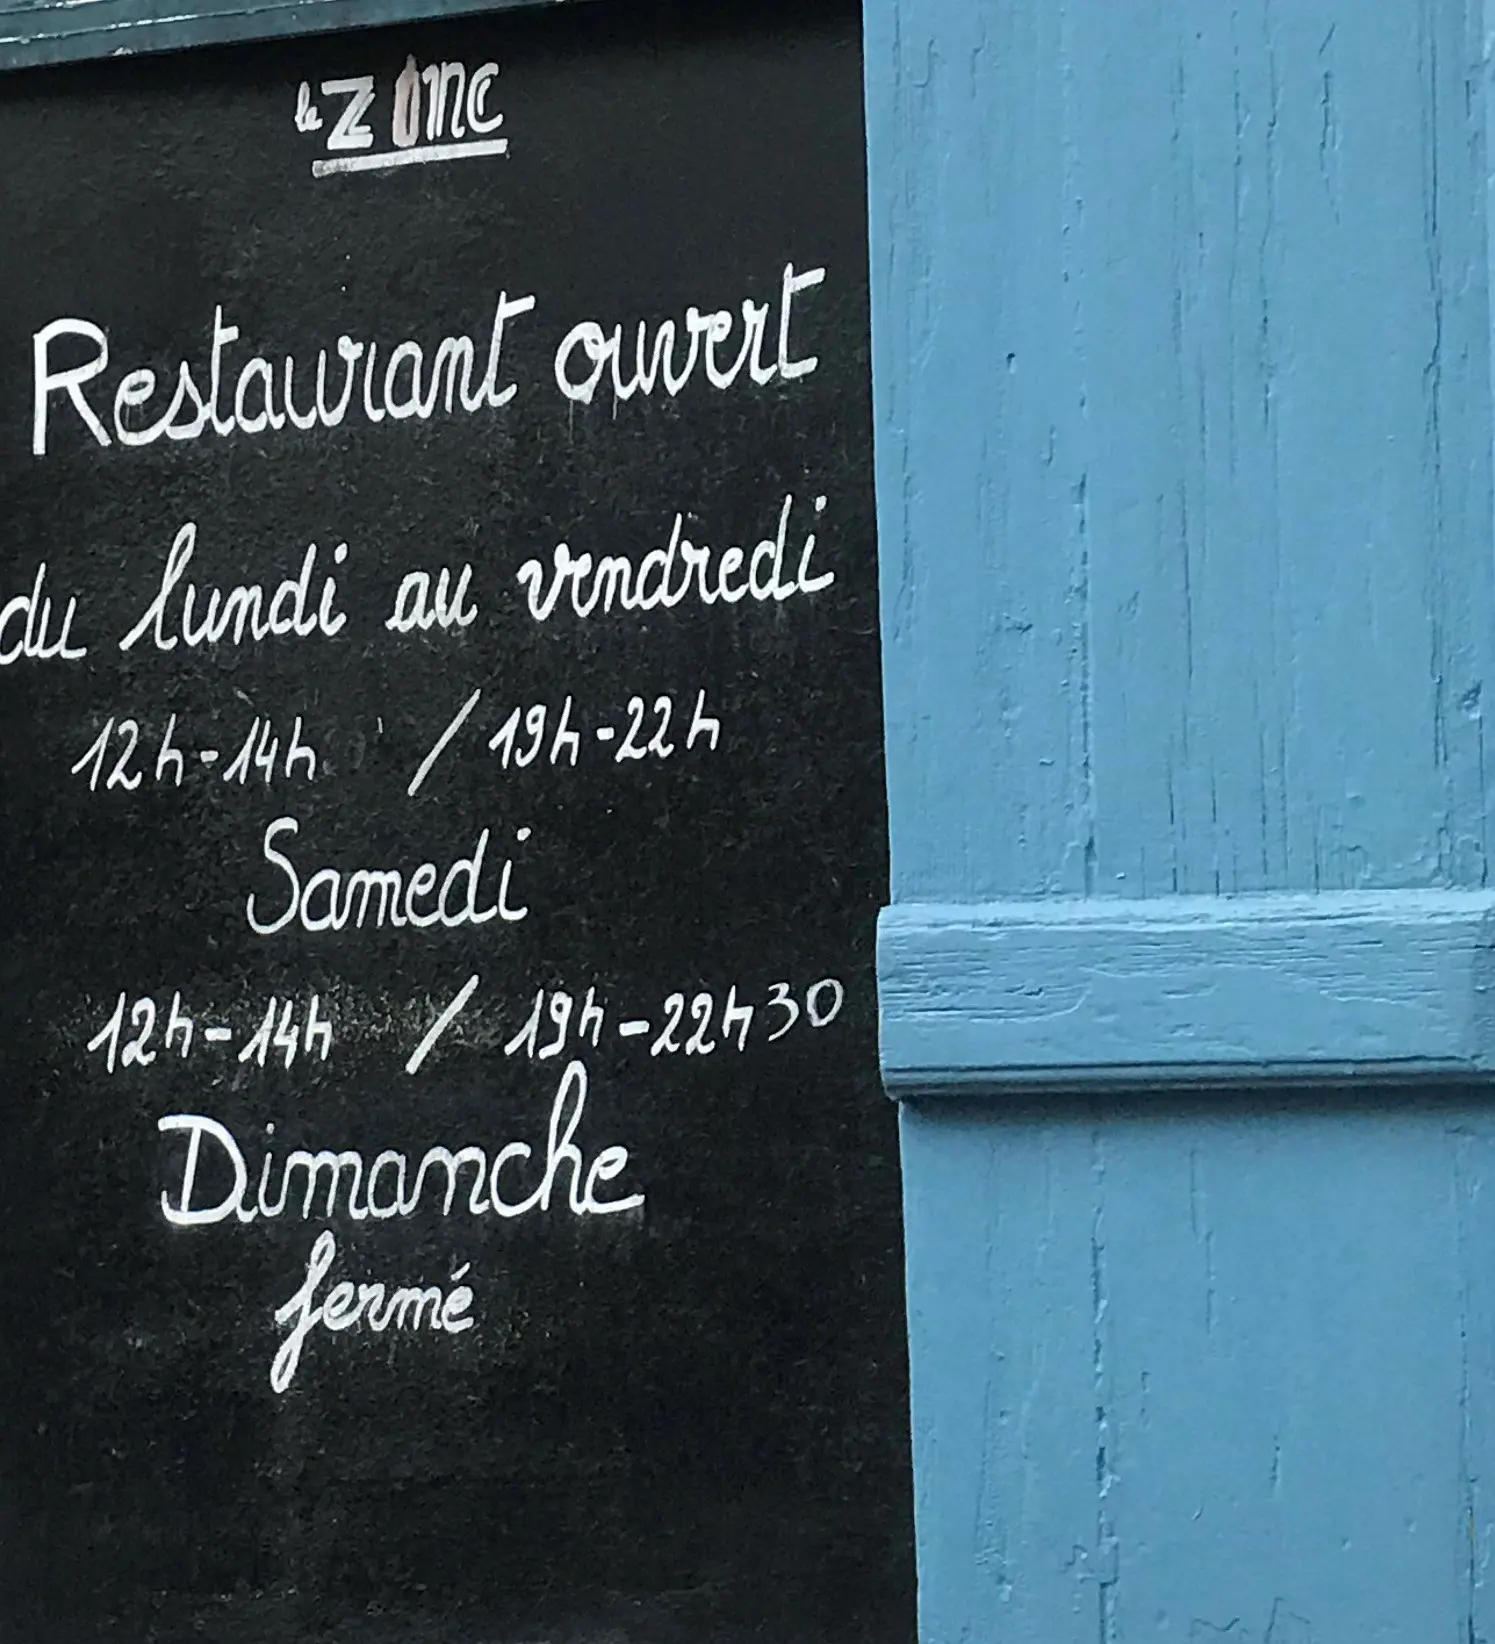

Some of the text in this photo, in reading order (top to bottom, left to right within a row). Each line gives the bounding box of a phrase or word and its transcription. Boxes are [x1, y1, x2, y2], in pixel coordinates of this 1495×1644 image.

[32, 263, 826, 455] Restaurant ouvert
[119, 522, 348, 651] lundi
[386, 564, 478, 633] au
[517, 495, 835, 622] vendredi
[246, 816, 531, 935] Samedi
[157, 1060, 645, 1226] Dimanche
[271, 1230, 474, 1394] fermé
